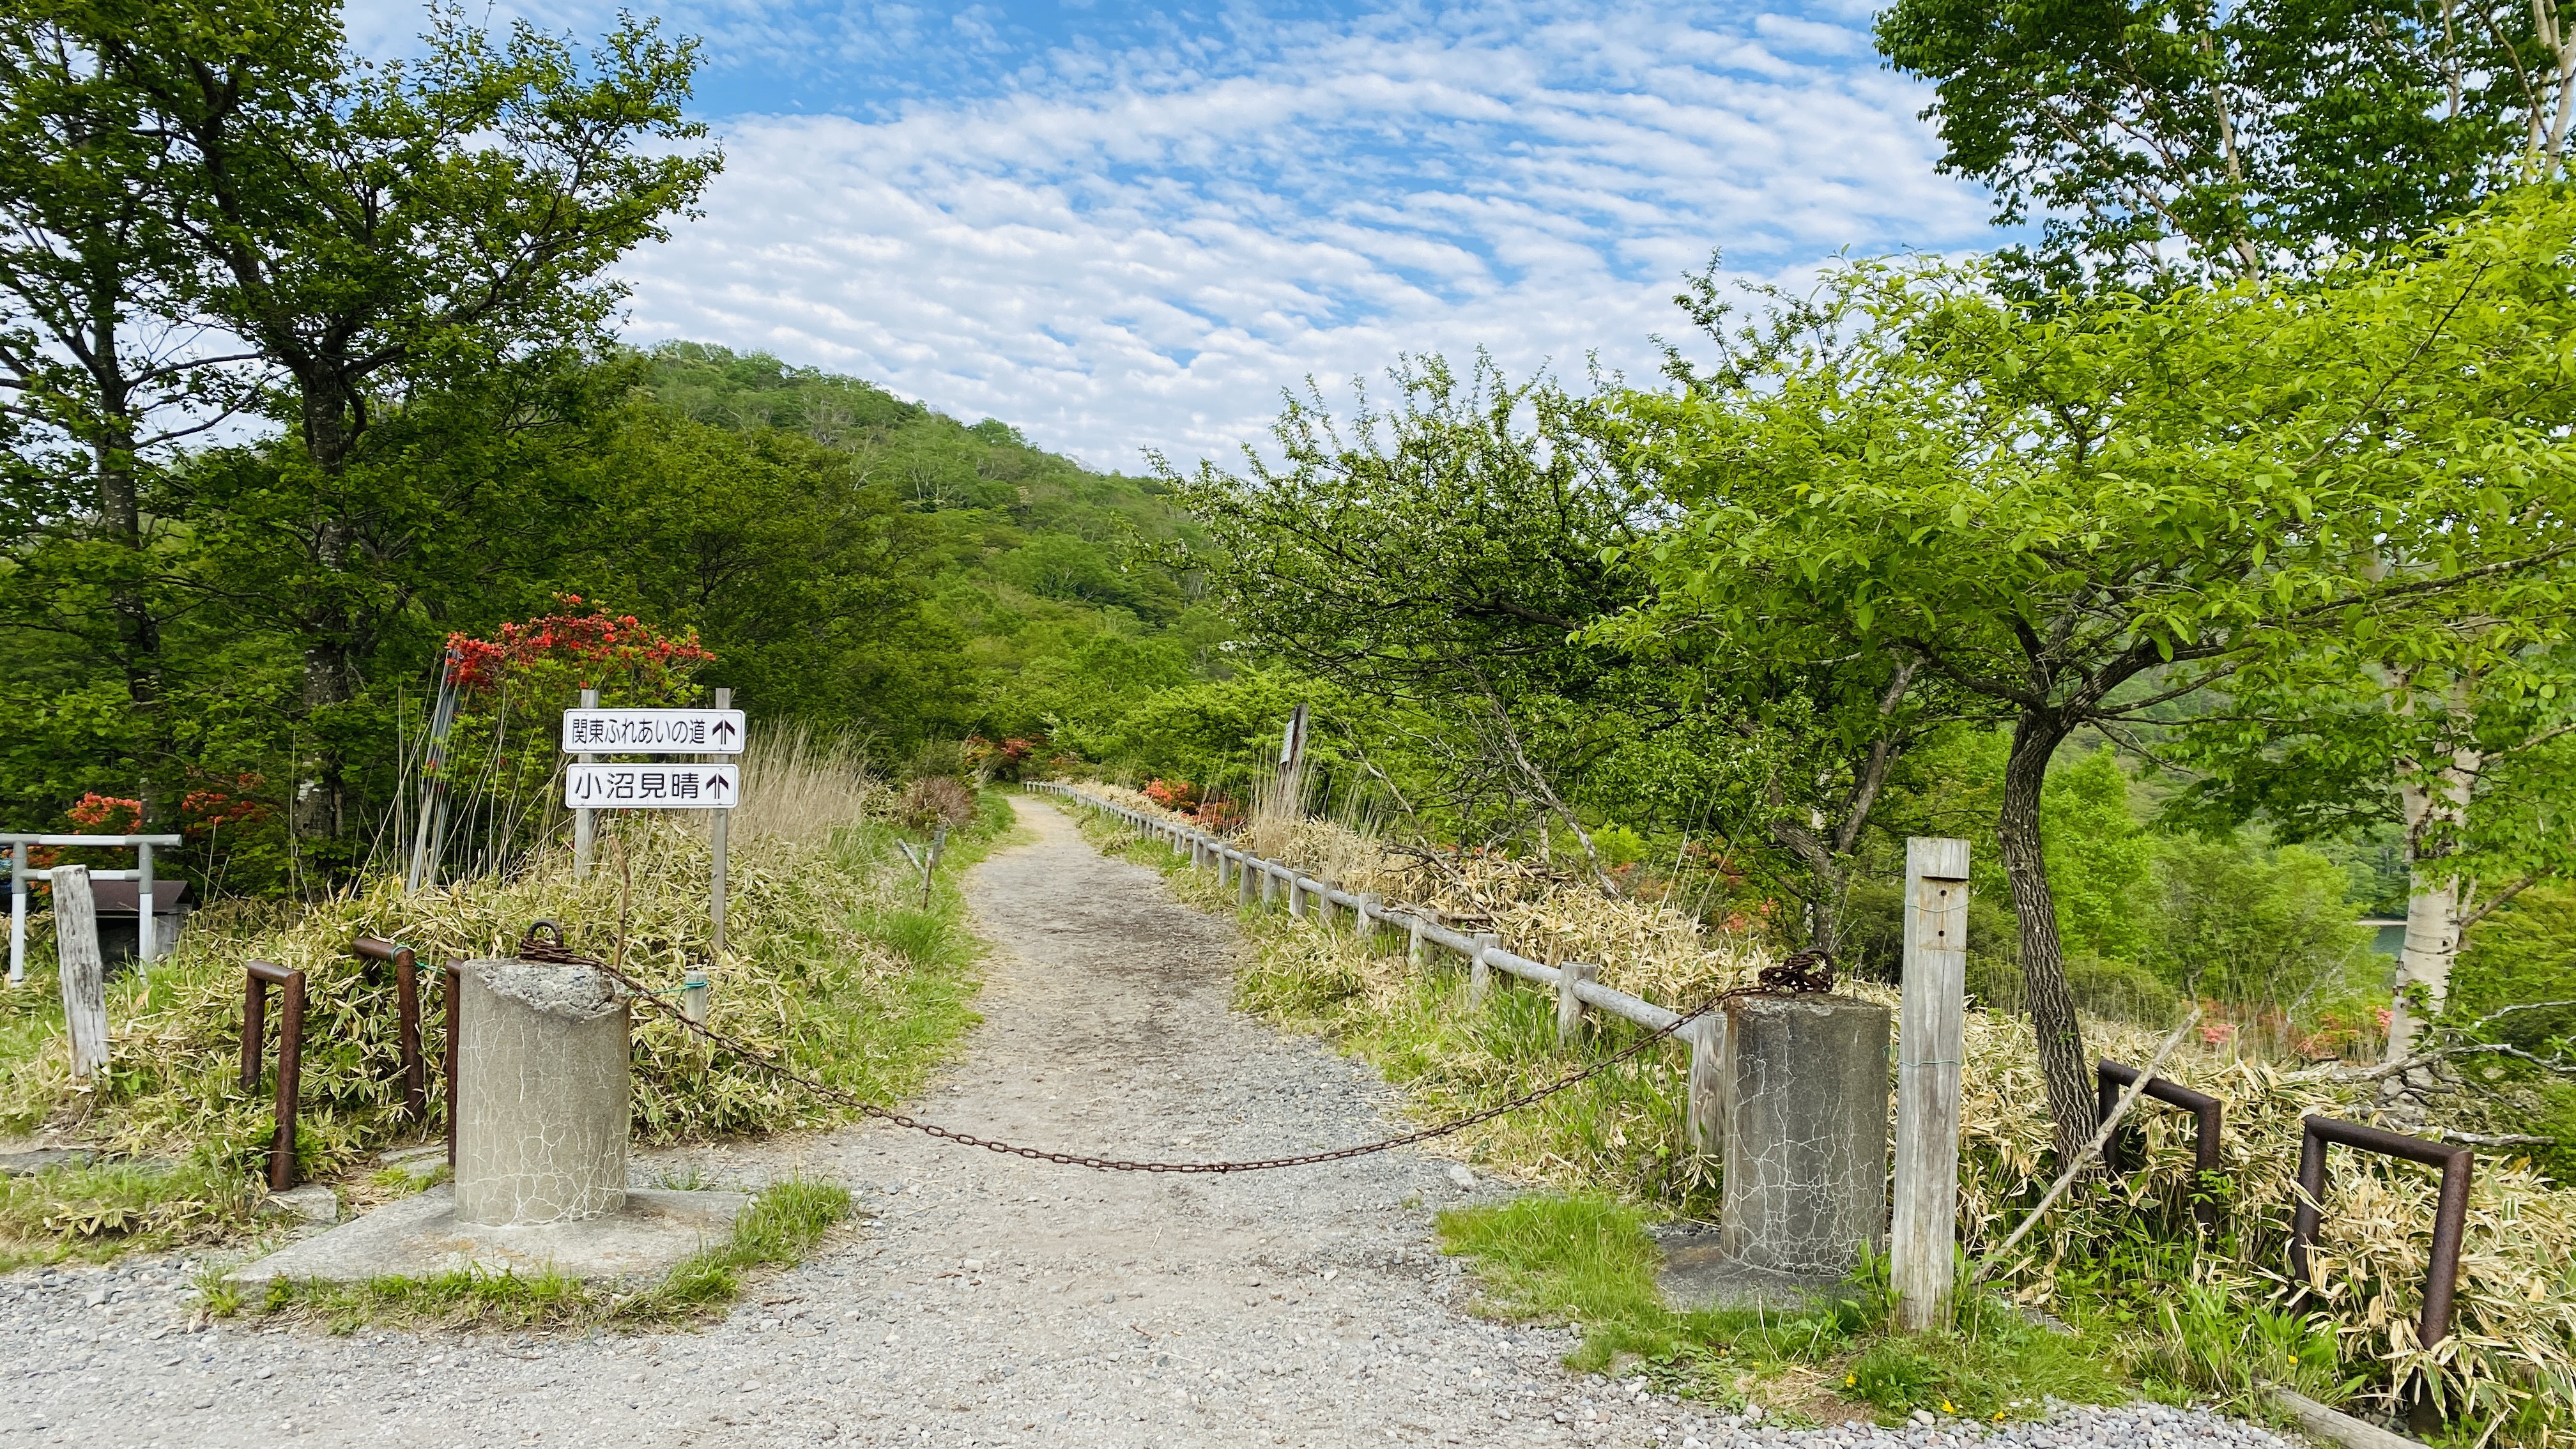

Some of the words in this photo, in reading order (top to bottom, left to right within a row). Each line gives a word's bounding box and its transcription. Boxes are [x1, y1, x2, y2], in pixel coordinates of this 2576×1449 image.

[572, 719, 705, 744] 関東ふれあいの道
[575, 772, 700, 799] 小沼見晴
